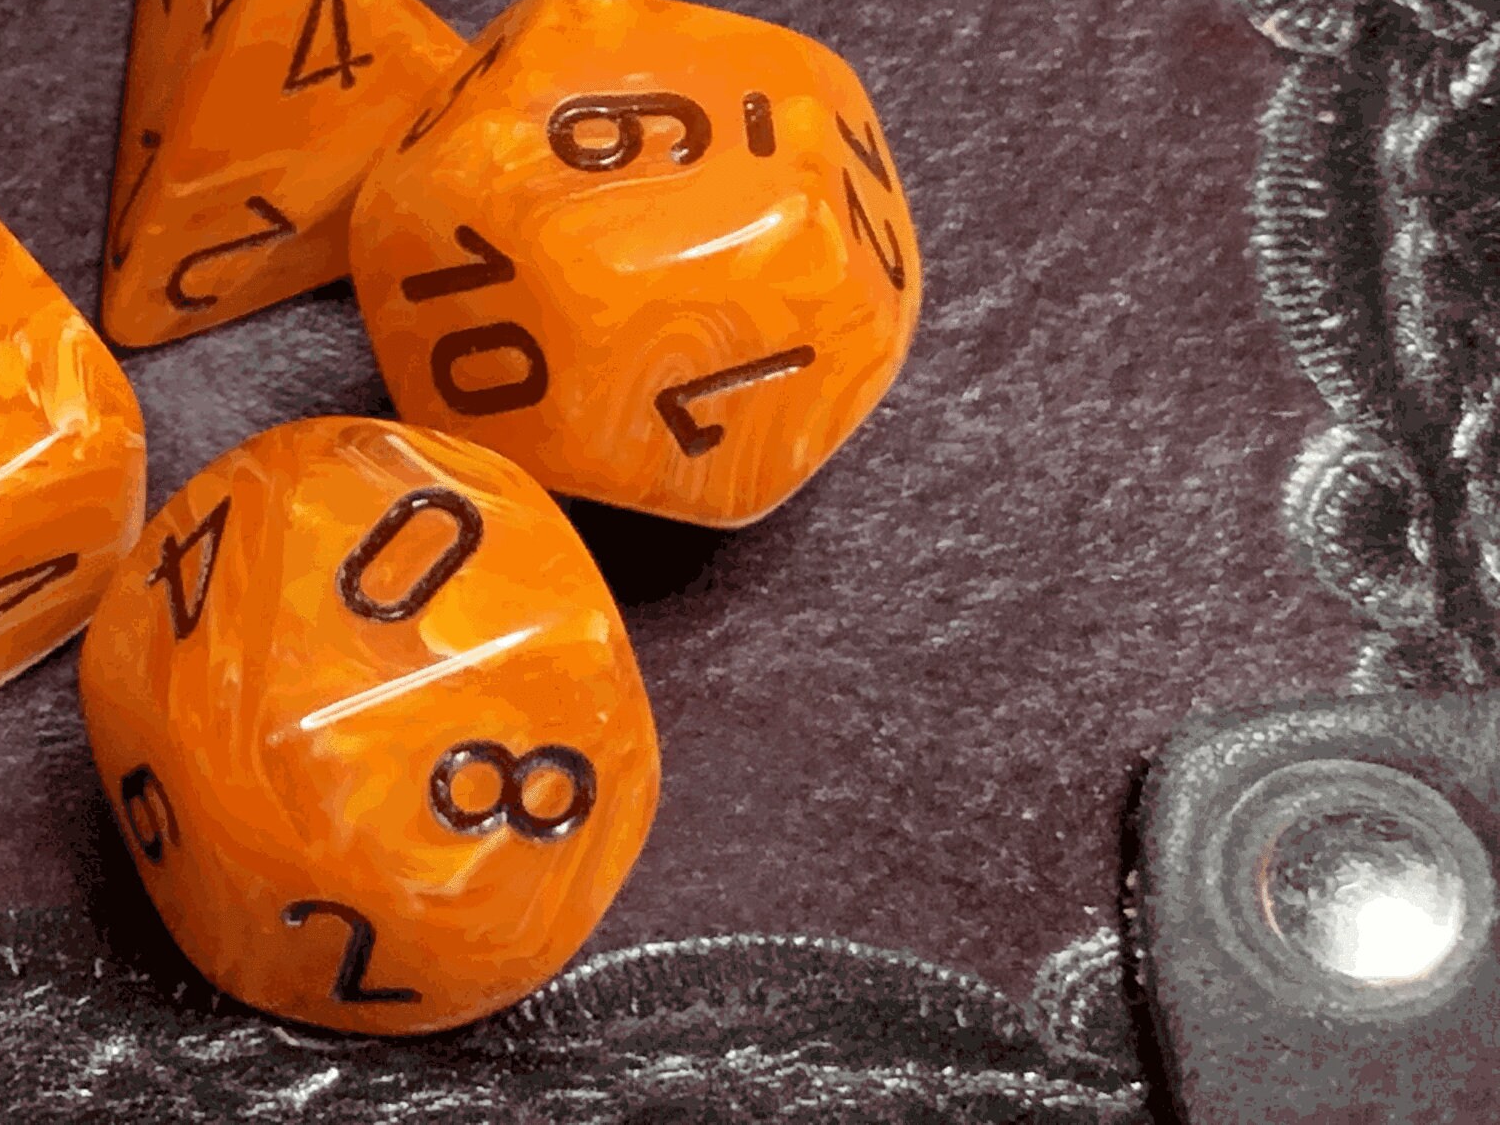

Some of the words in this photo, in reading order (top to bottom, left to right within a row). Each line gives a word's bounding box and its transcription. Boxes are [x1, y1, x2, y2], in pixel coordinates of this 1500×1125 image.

[165, 196, 297, 310] 2
[400, 225, 550, 418] 10
[147, 495, 232, 641] 4
[336, 487, 484, 623] 0
[429, 740, 598, 843] 8
[280, 900, 423, 1005] 2
